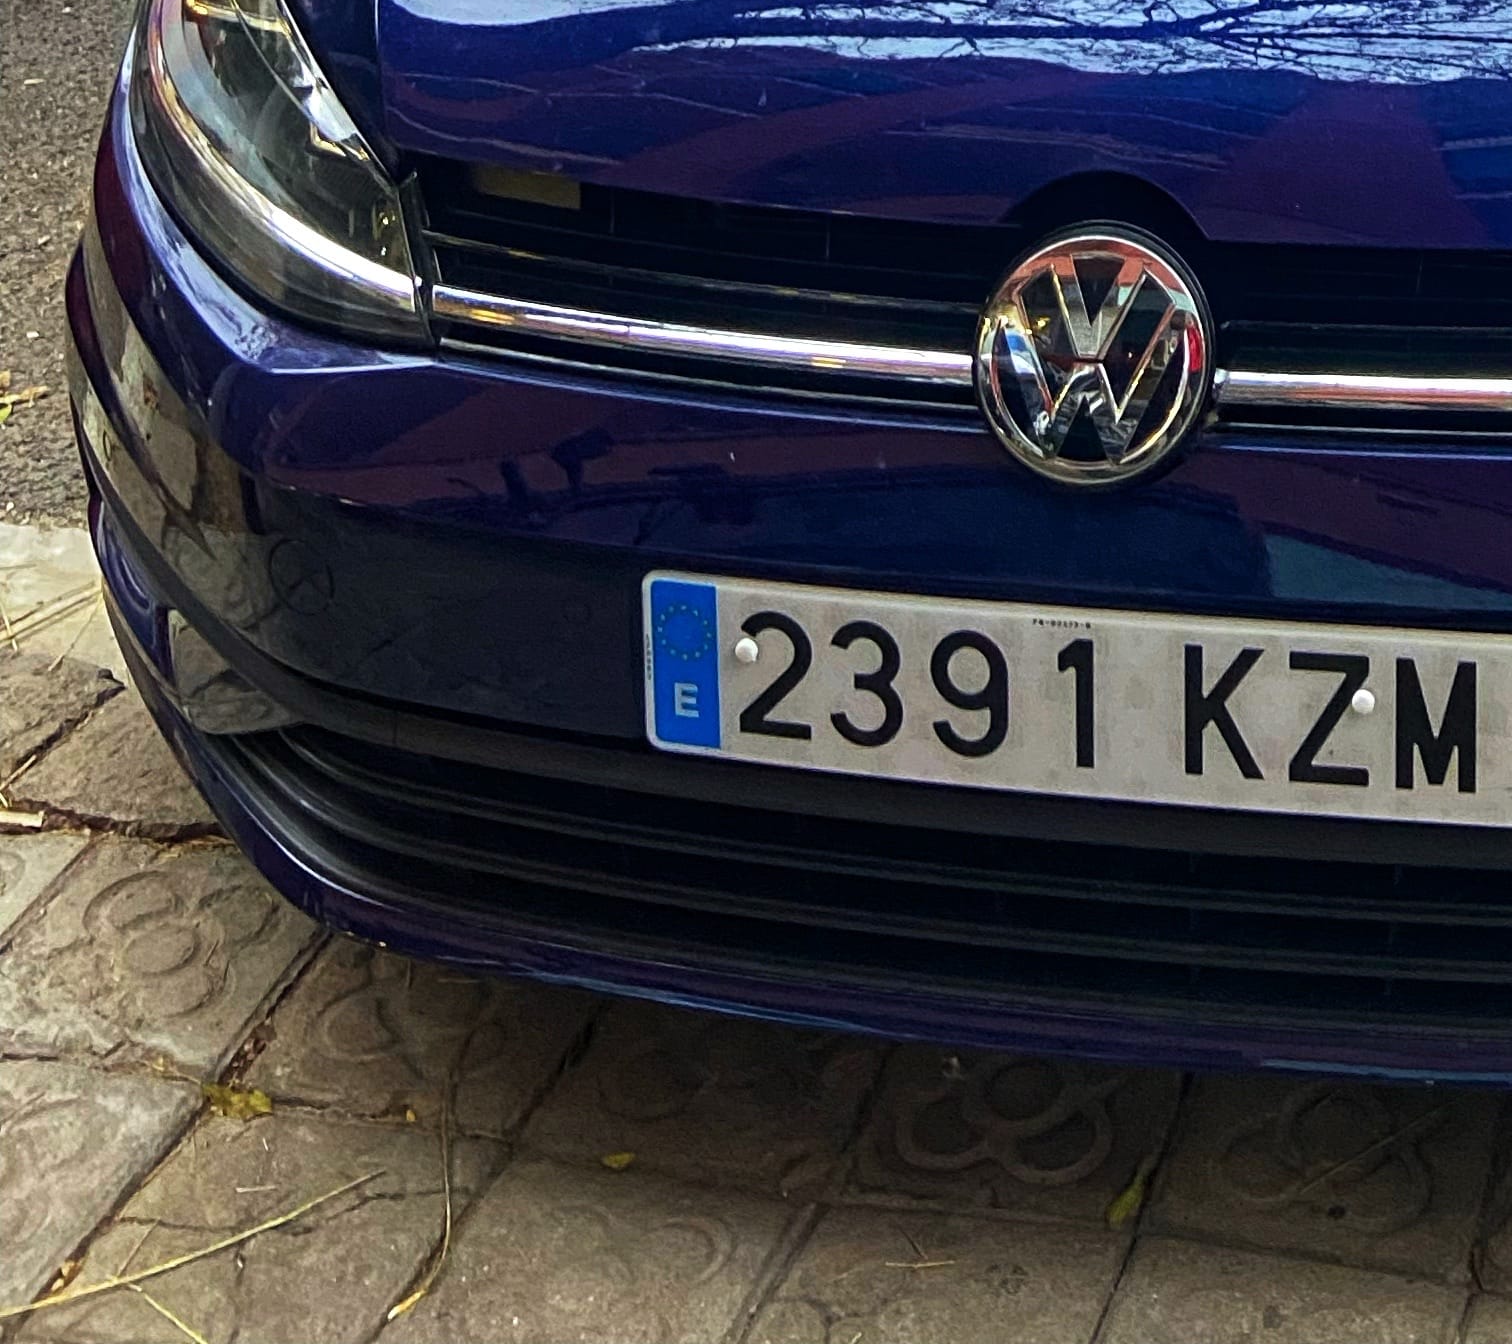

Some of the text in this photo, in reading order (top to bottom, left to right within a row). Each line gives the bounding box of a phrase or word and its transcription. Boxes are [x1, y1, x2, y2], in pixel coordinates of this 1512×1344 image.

[674, 682, 700, 718] E
[739, 611, 1477, 794] 2391 KZM
